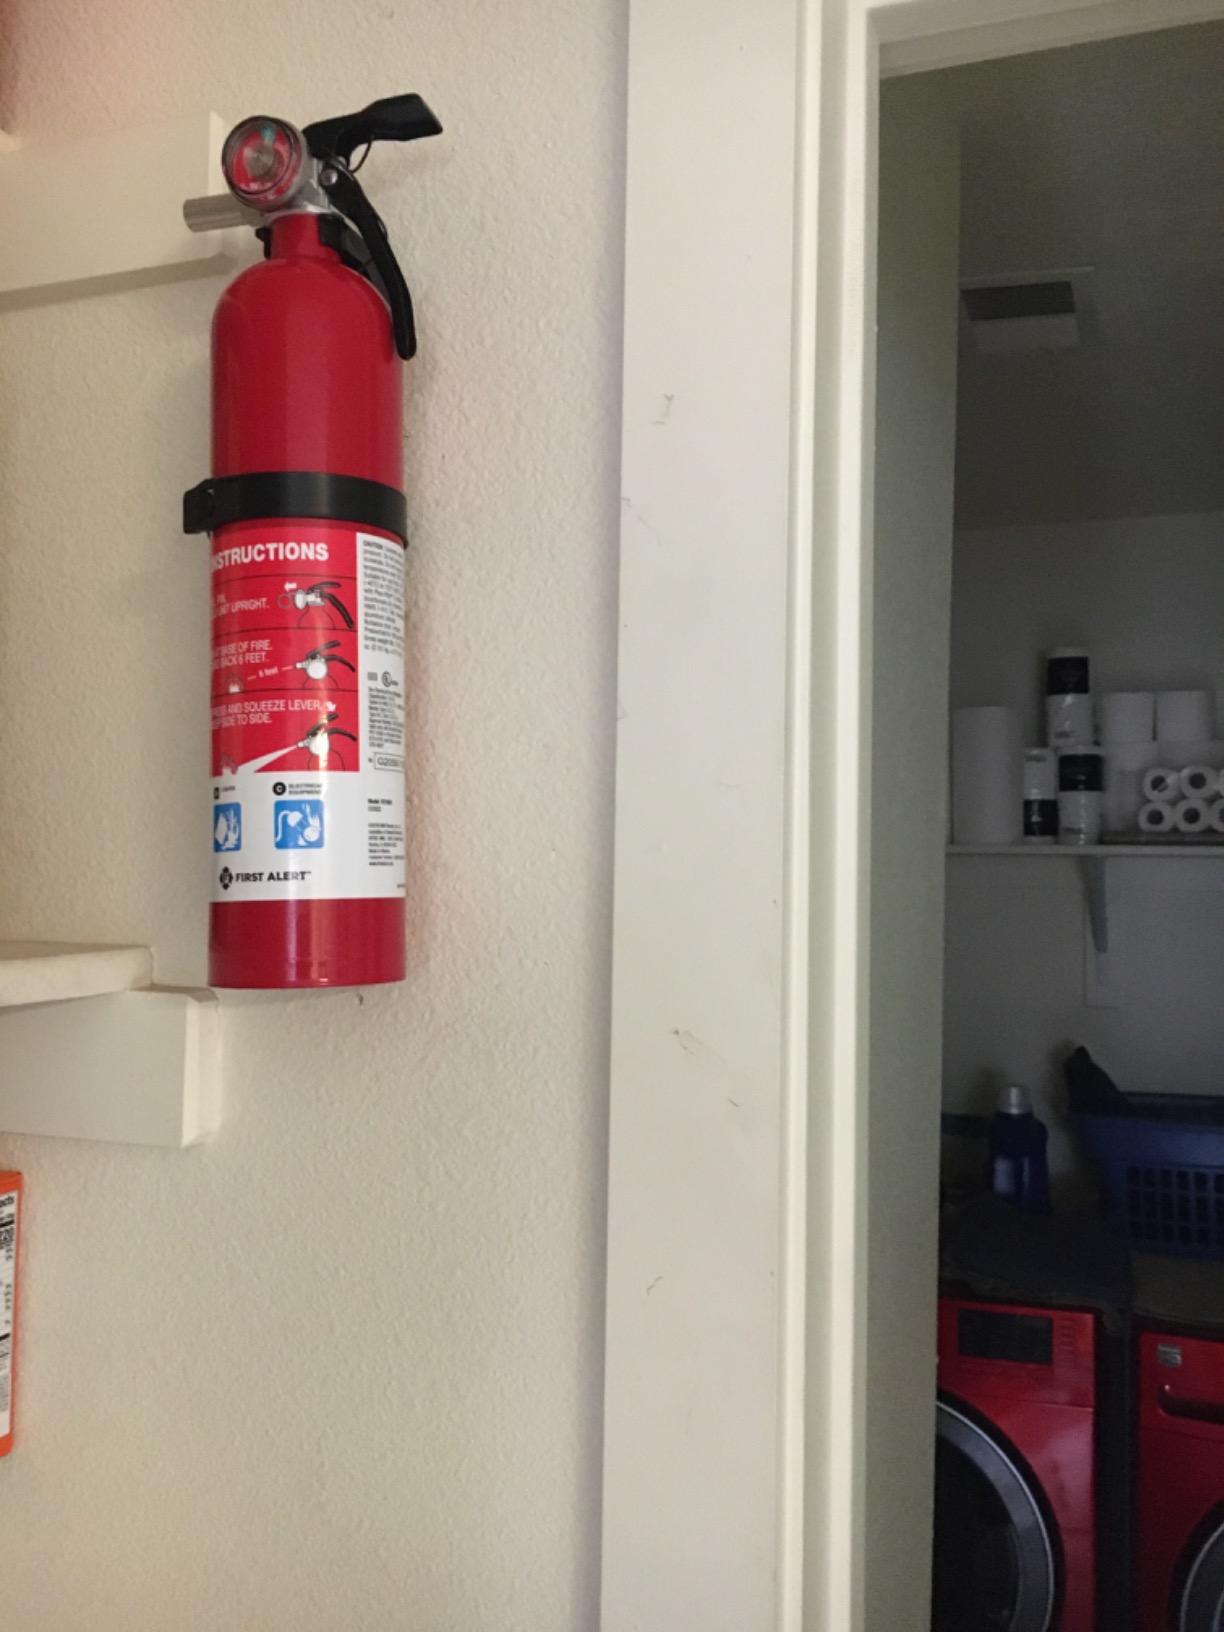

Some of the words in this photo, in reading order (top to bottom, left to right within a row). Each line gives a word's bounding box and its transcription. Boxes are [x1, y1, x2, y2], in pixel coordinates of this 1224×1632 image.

[244, 699, 287, 712] SQUEEZE
[237, 713, 249, 726] TO
[235, 872, 264, 883] FIRST
